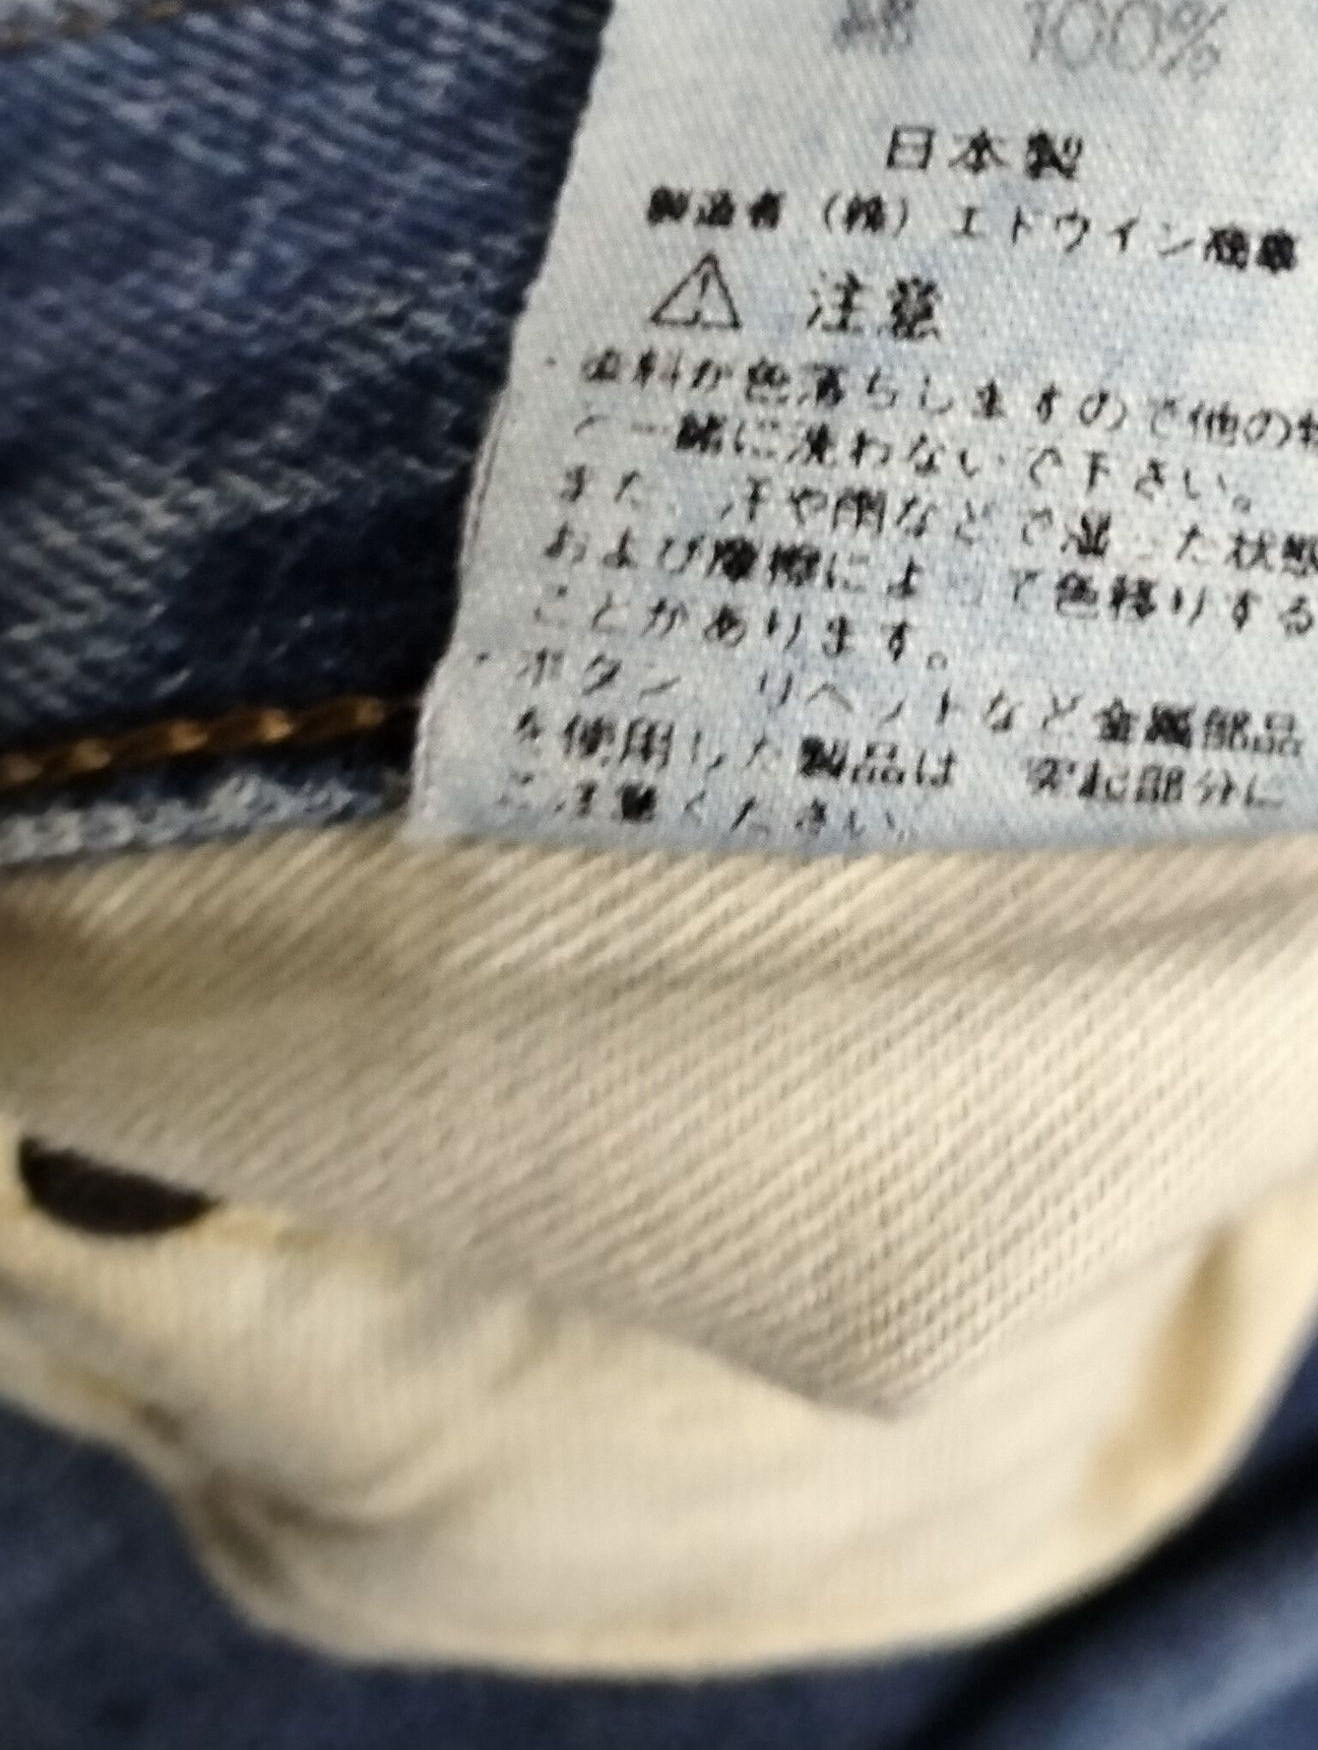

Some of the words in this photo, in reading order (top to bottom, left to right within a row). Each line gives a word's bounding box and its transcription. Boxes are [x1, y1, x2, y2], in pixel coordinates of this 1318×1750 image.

[886, 123, 1084, 182] 日本製
[806, 267, 941, 341] 注意
